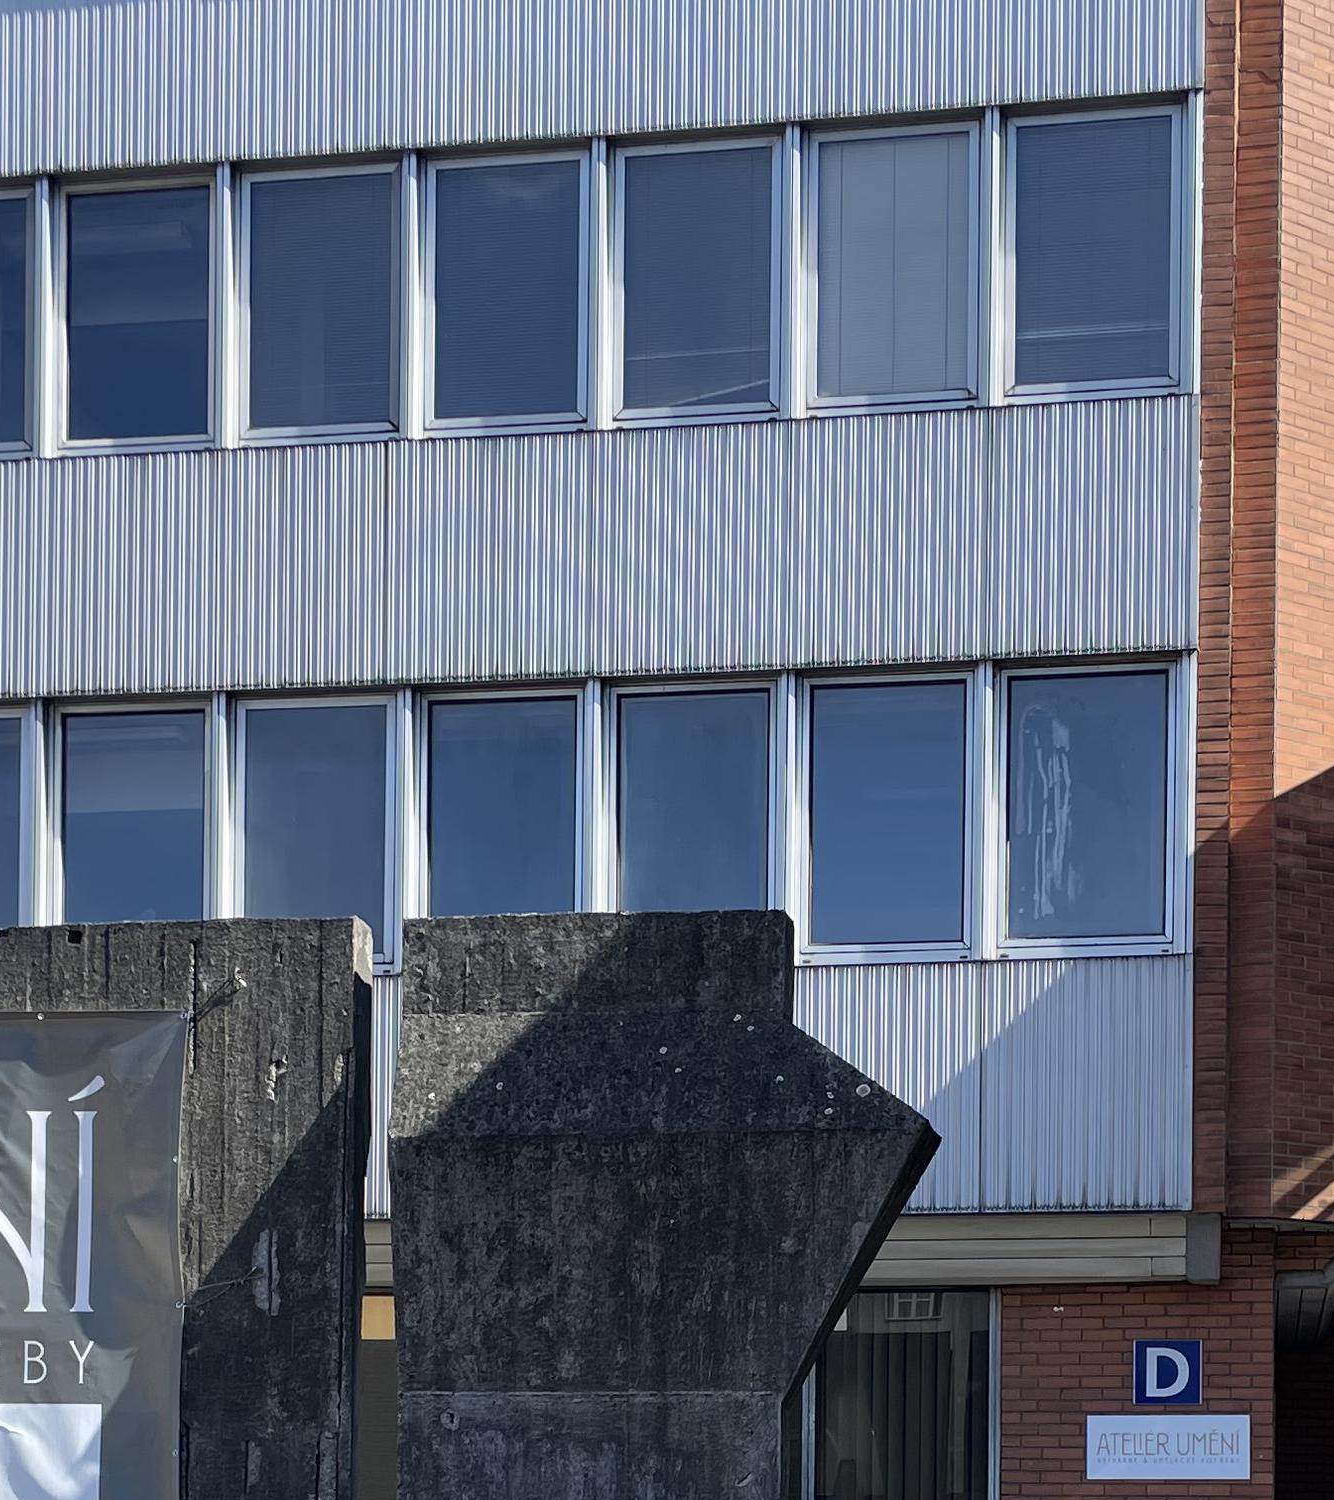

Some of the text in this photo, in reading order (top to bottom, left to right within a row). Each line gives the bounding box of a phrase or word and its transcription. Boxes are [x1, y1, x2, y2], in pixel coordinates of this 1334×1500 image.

[1146, 1347, 1190, 1398] D
[1096, 1427, 1241, 1457] ATELIÉR UMĚNÍ
